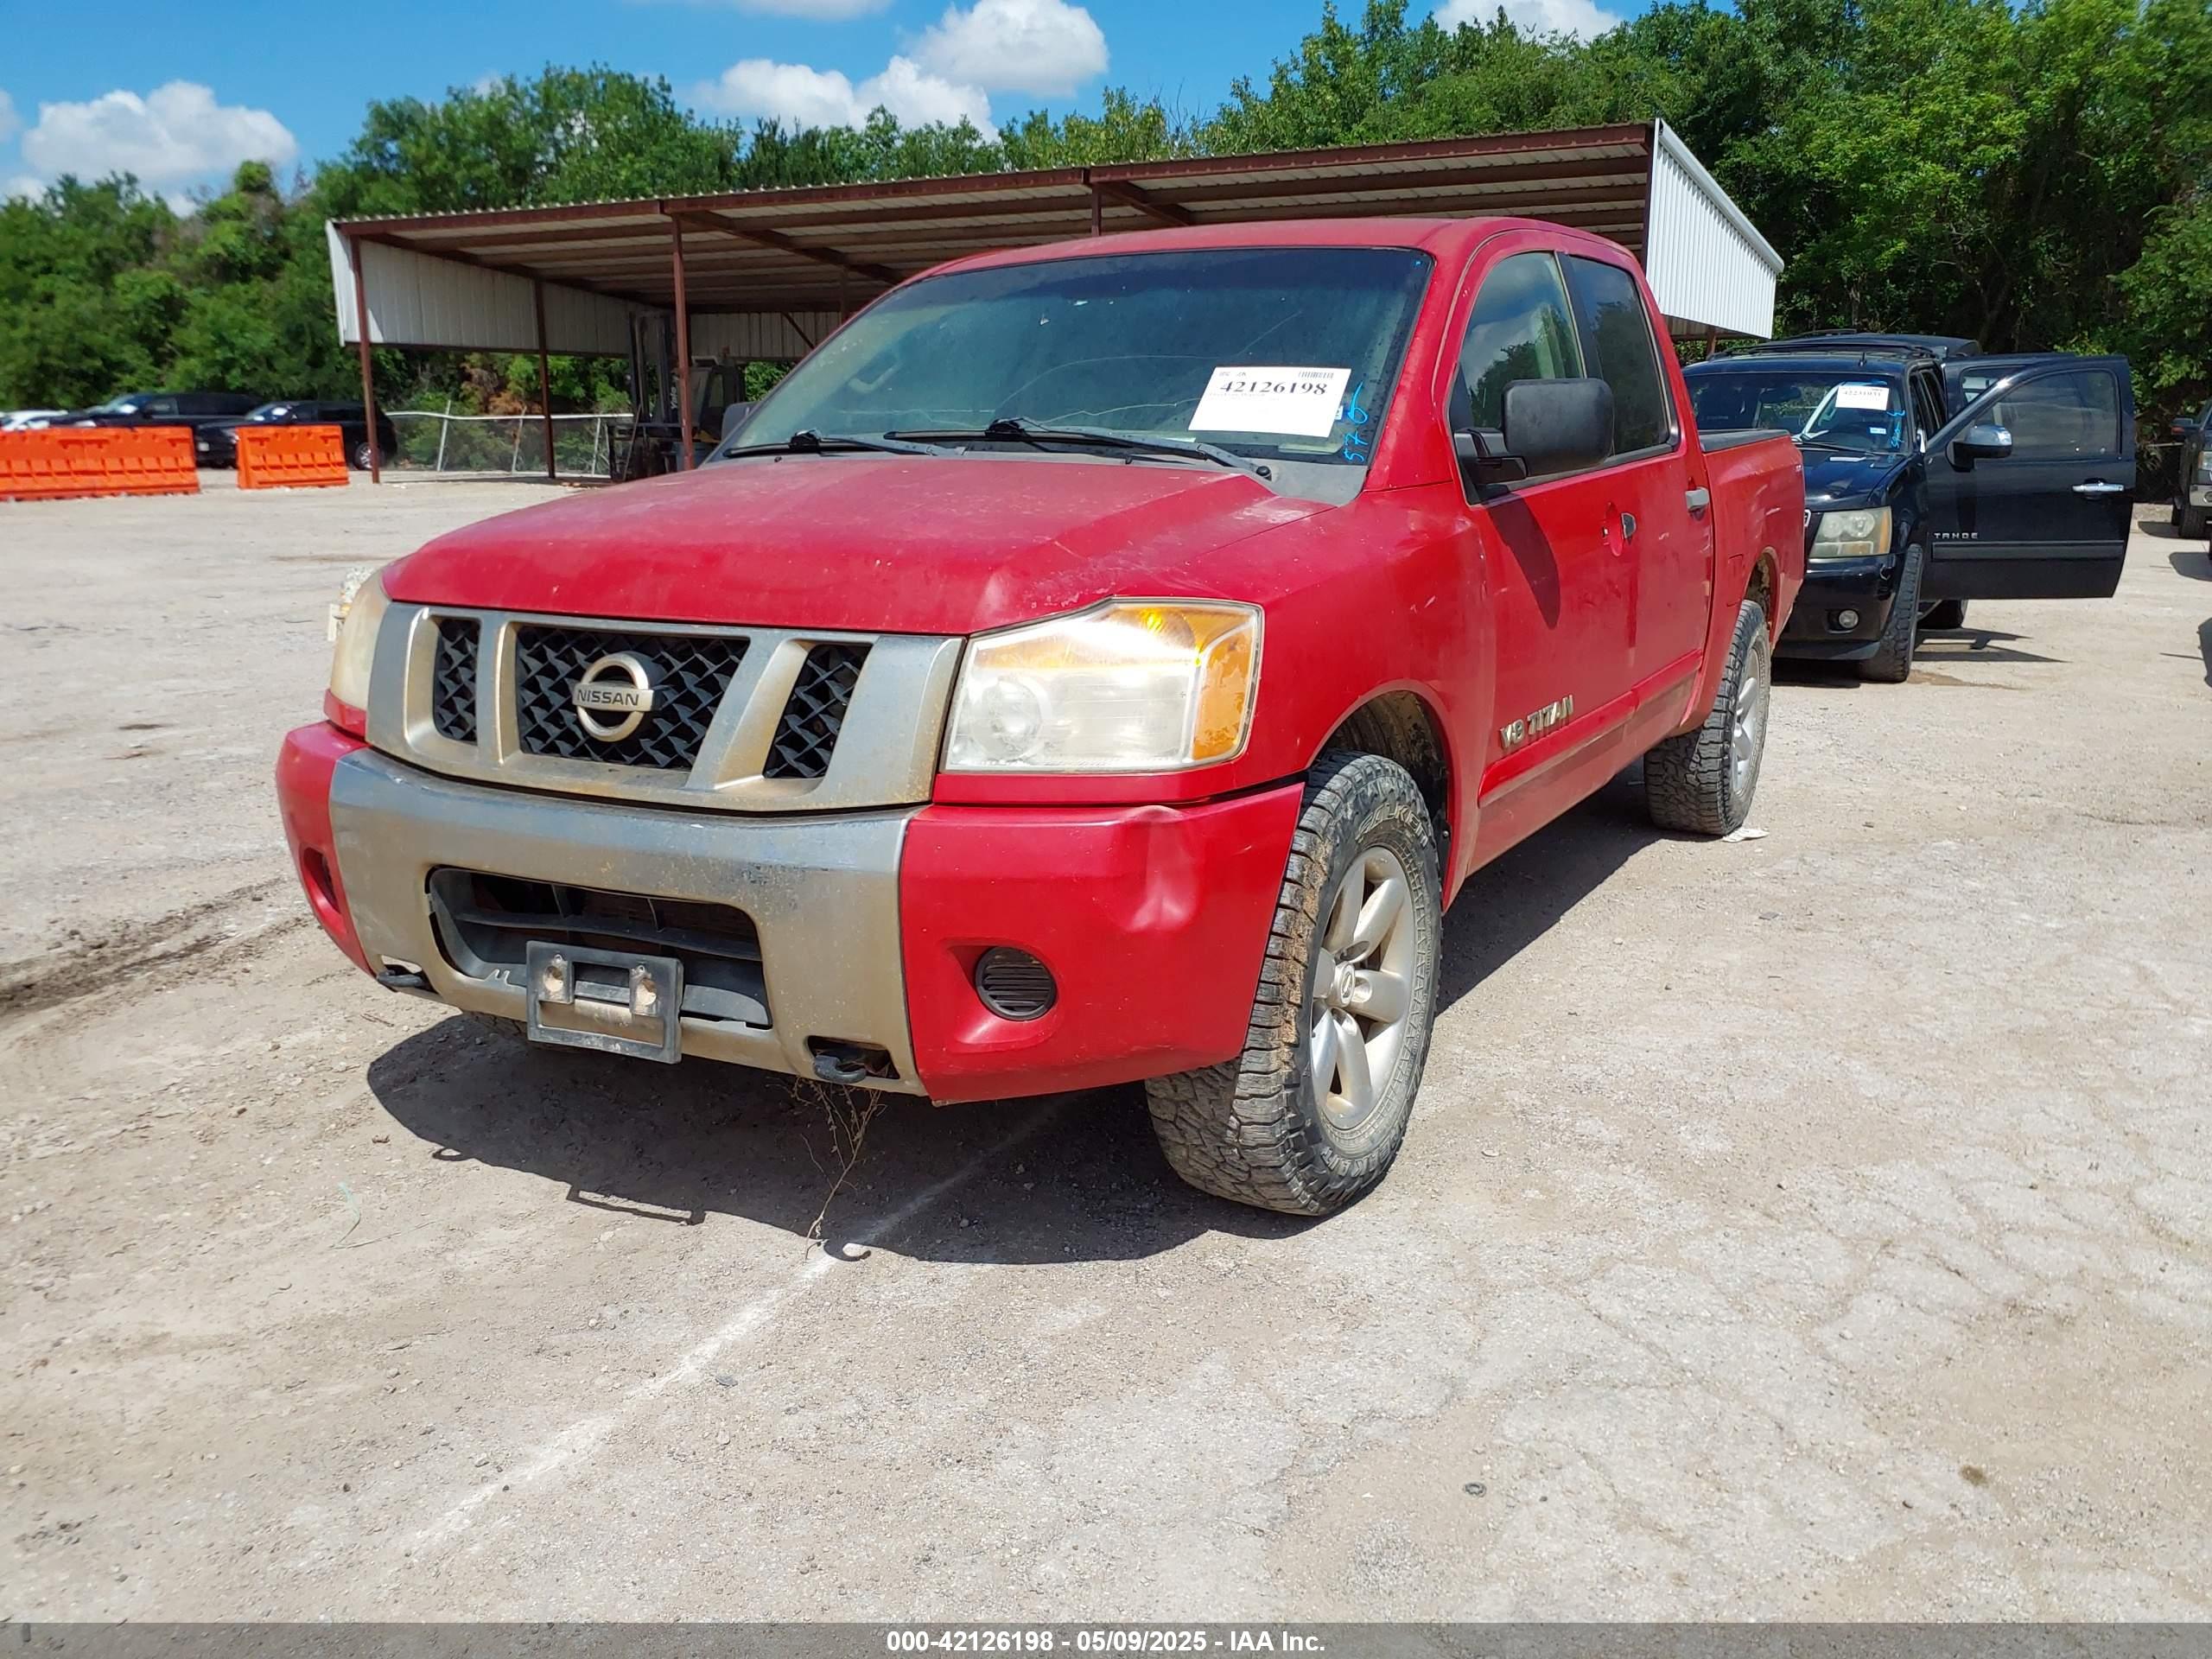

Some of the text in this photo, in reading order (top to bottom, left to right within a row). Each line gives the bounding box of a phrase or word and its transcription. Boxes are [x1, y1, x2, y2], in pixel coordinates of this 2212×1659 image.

[1219, 380, 1328, 395] 42126198
[577, 690, 639, 706] NISSAN
[1527, 694, 1574, 735] TITAN
